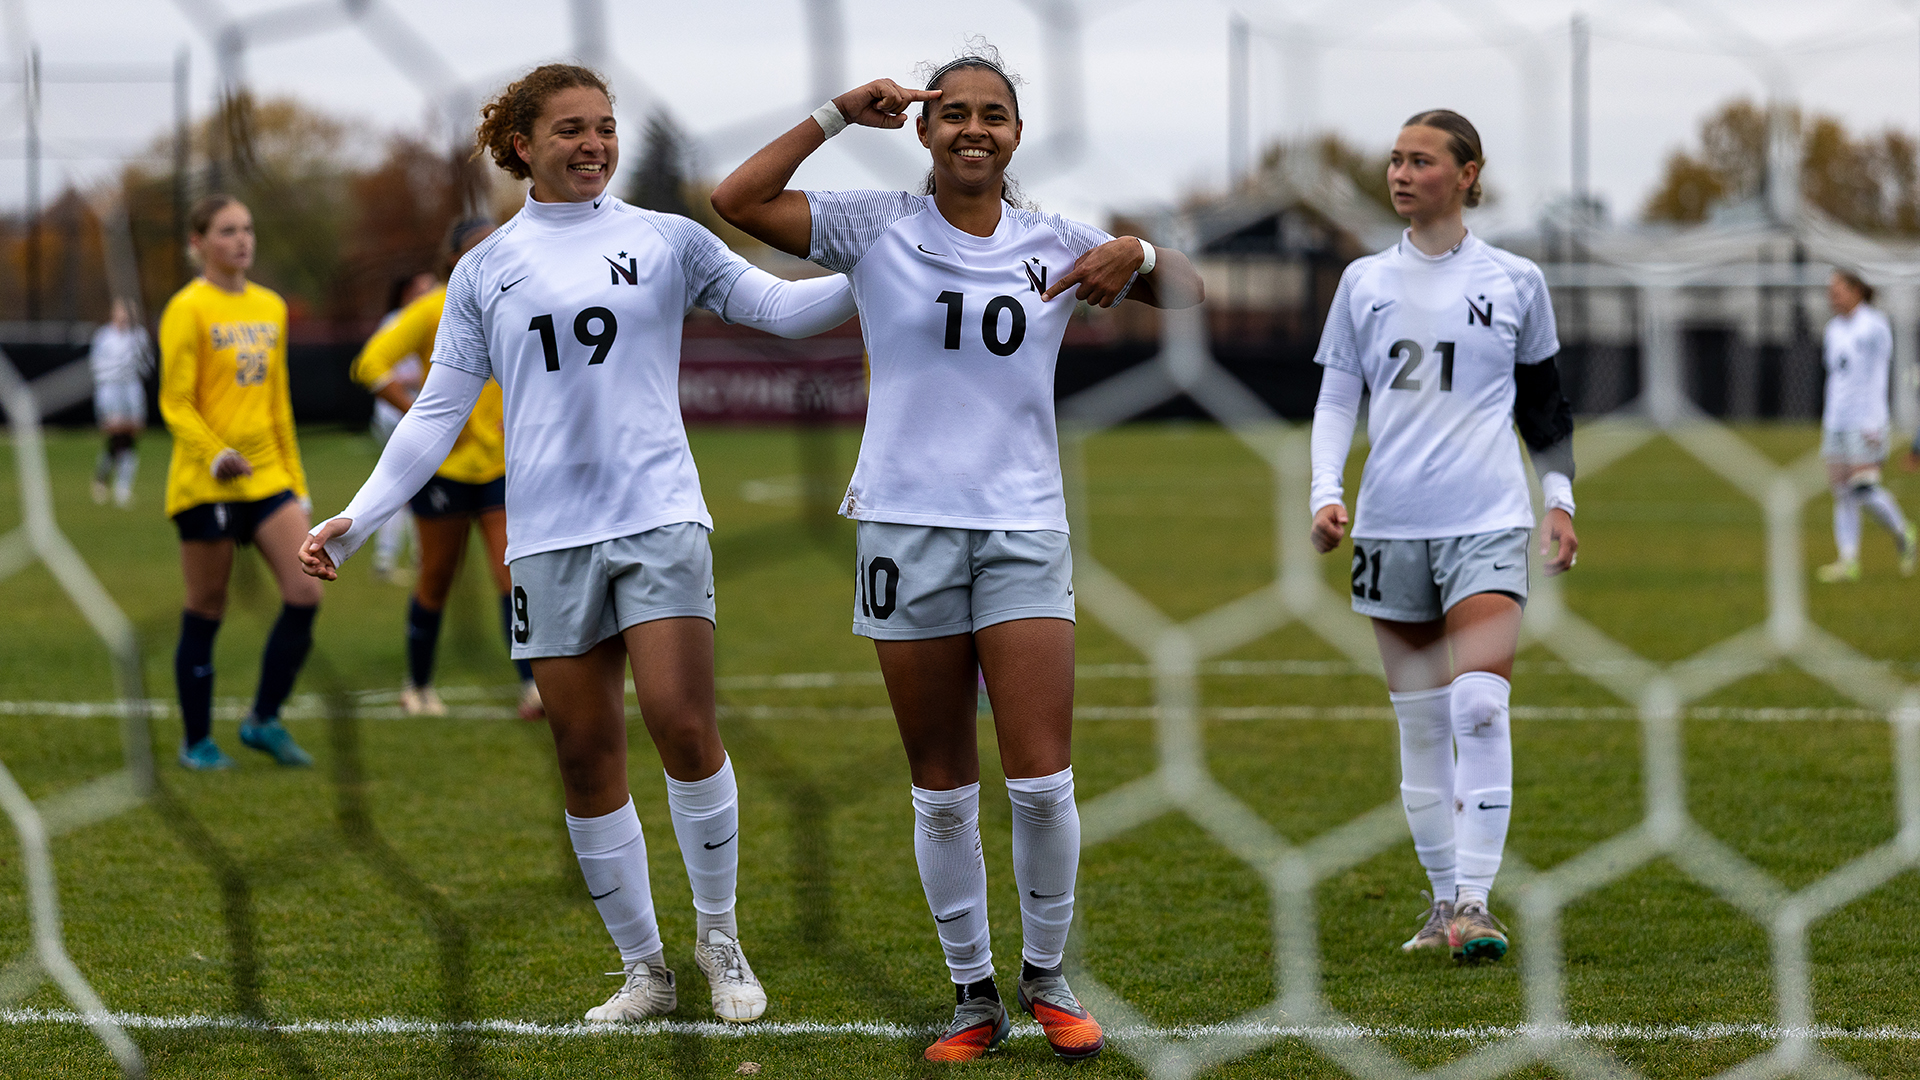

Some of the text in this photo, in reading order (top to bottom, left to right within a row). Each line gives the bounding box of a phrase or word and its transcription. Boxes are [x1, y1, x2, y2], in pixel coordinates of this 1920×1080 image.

[528, 306, 618, 372] 19
[935, 290, 1027, 357] 10
[1388, 339, 1456, 392] 21
[1352, 546, 1381, 601] 21
